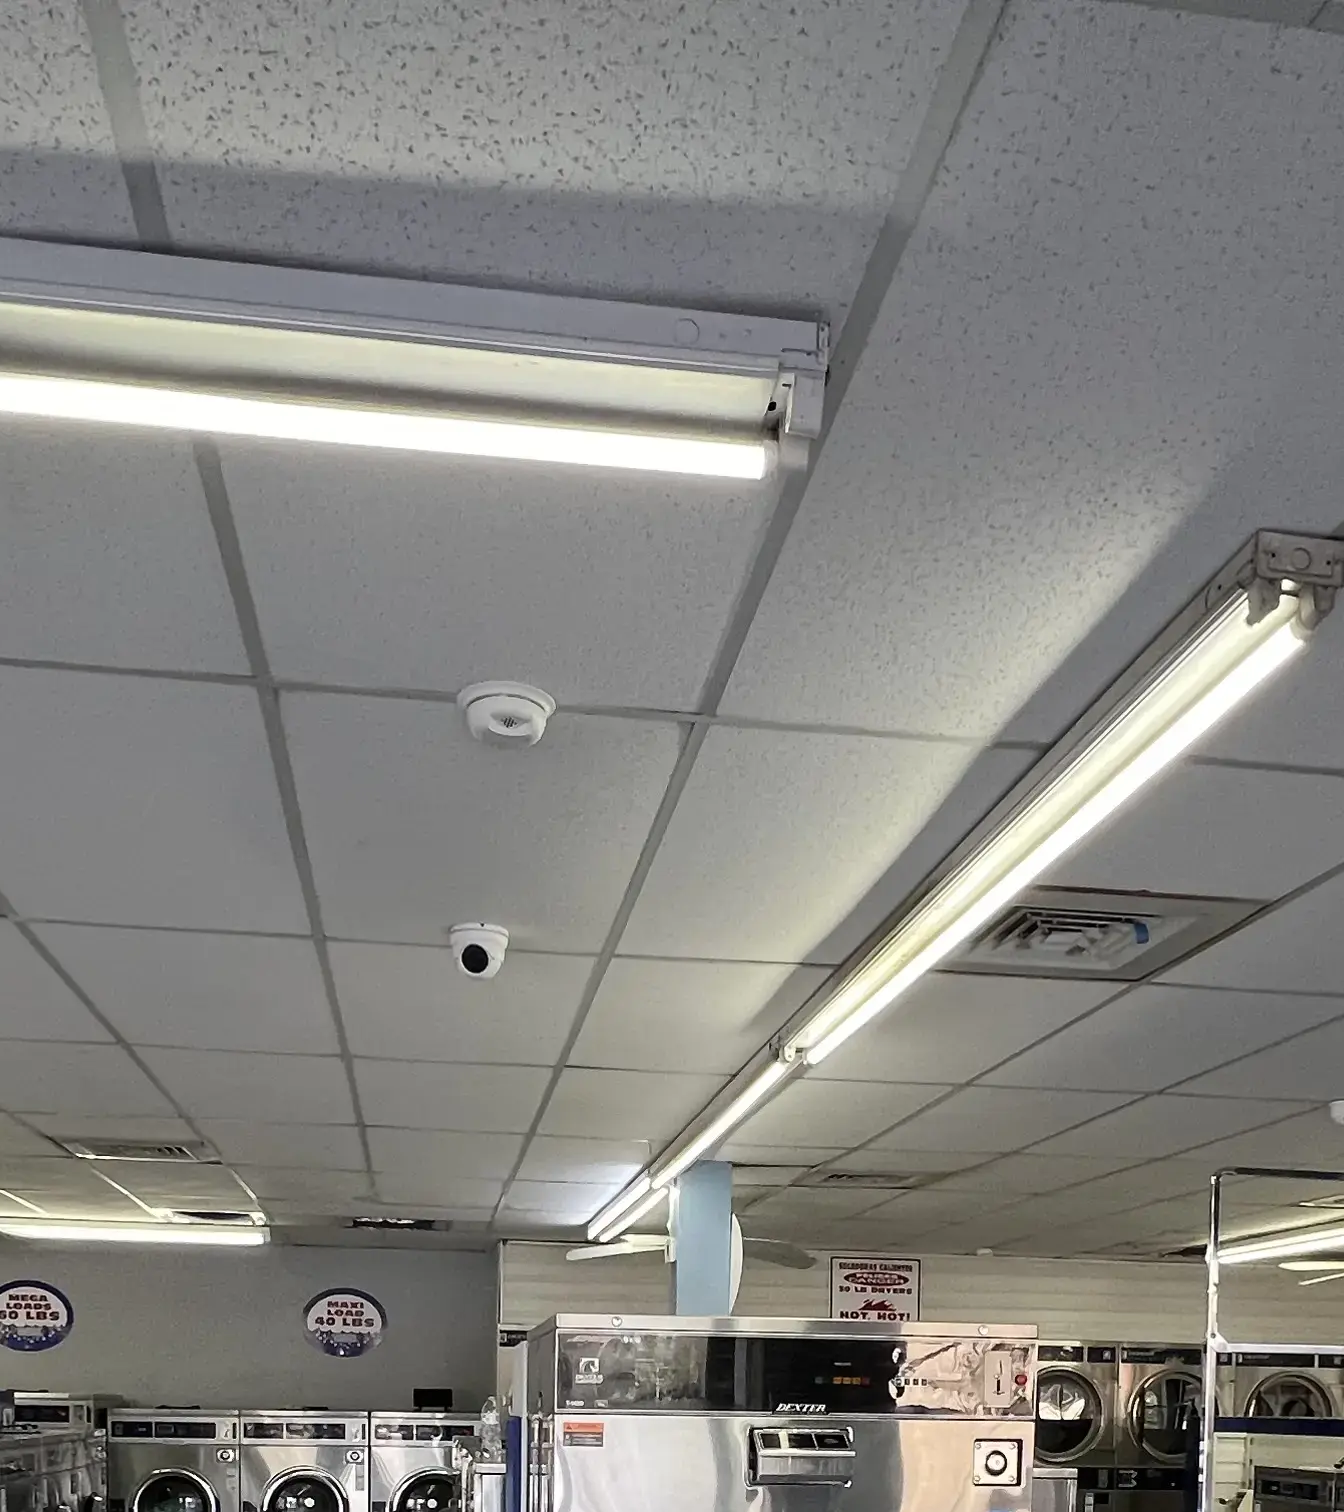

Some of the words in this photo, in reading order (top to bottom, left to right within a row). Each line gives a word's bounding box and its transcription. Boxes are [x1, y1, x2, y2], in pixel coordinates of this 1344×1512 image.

[8, 1294, 48, 1302] MEGA
[6, 1303, 52, 1311] LOADS
[327, 1301, 364, 1309] MAXI
[26, 1311, 60, 1321] LBS
[327, 1309, 364, 1317] LOAD
[315, 1316, 336, 1326] 40
[342, 1318, 375, 1328] LBS
[775, 1402, 828, 1413] DEXTER
